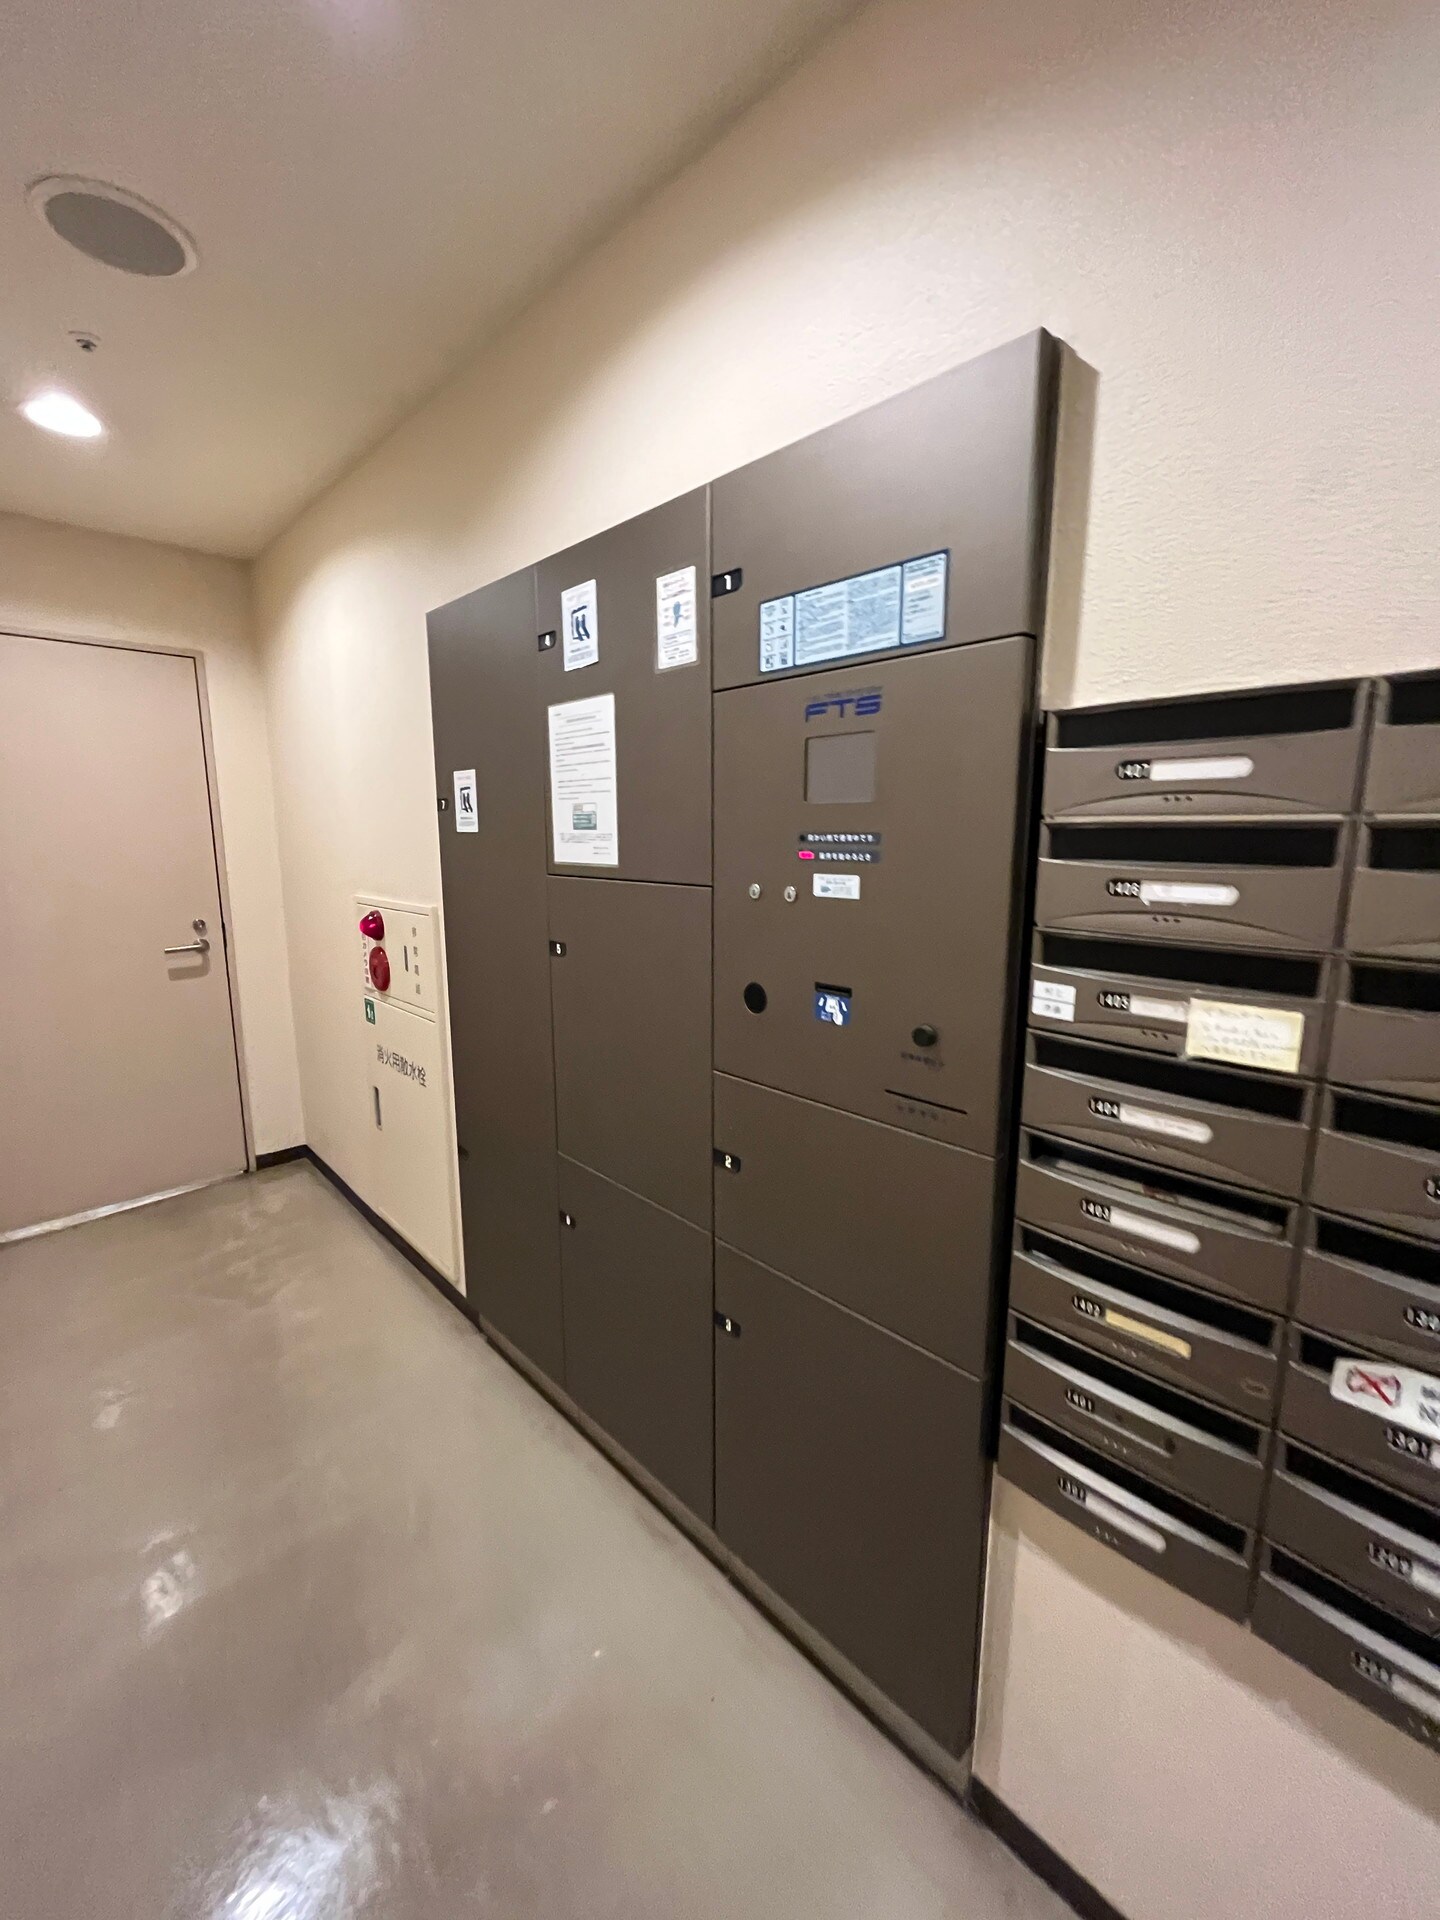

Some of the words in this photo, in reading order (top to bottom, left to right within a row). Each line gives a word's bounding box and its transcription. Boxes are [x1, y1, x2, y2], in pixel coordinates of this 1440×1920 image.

[723, 574, 732, 590] 1
[804, 694, 882, 723] FTS
[555, 943, 562, 955] 5
[1099, 992, 1129, 1009] 1405
[724, 1154, 733, 1169] 2
[1073, 1295, 1102, 1318] 1402
[1066, 1388, 1093, 1413] 1401
